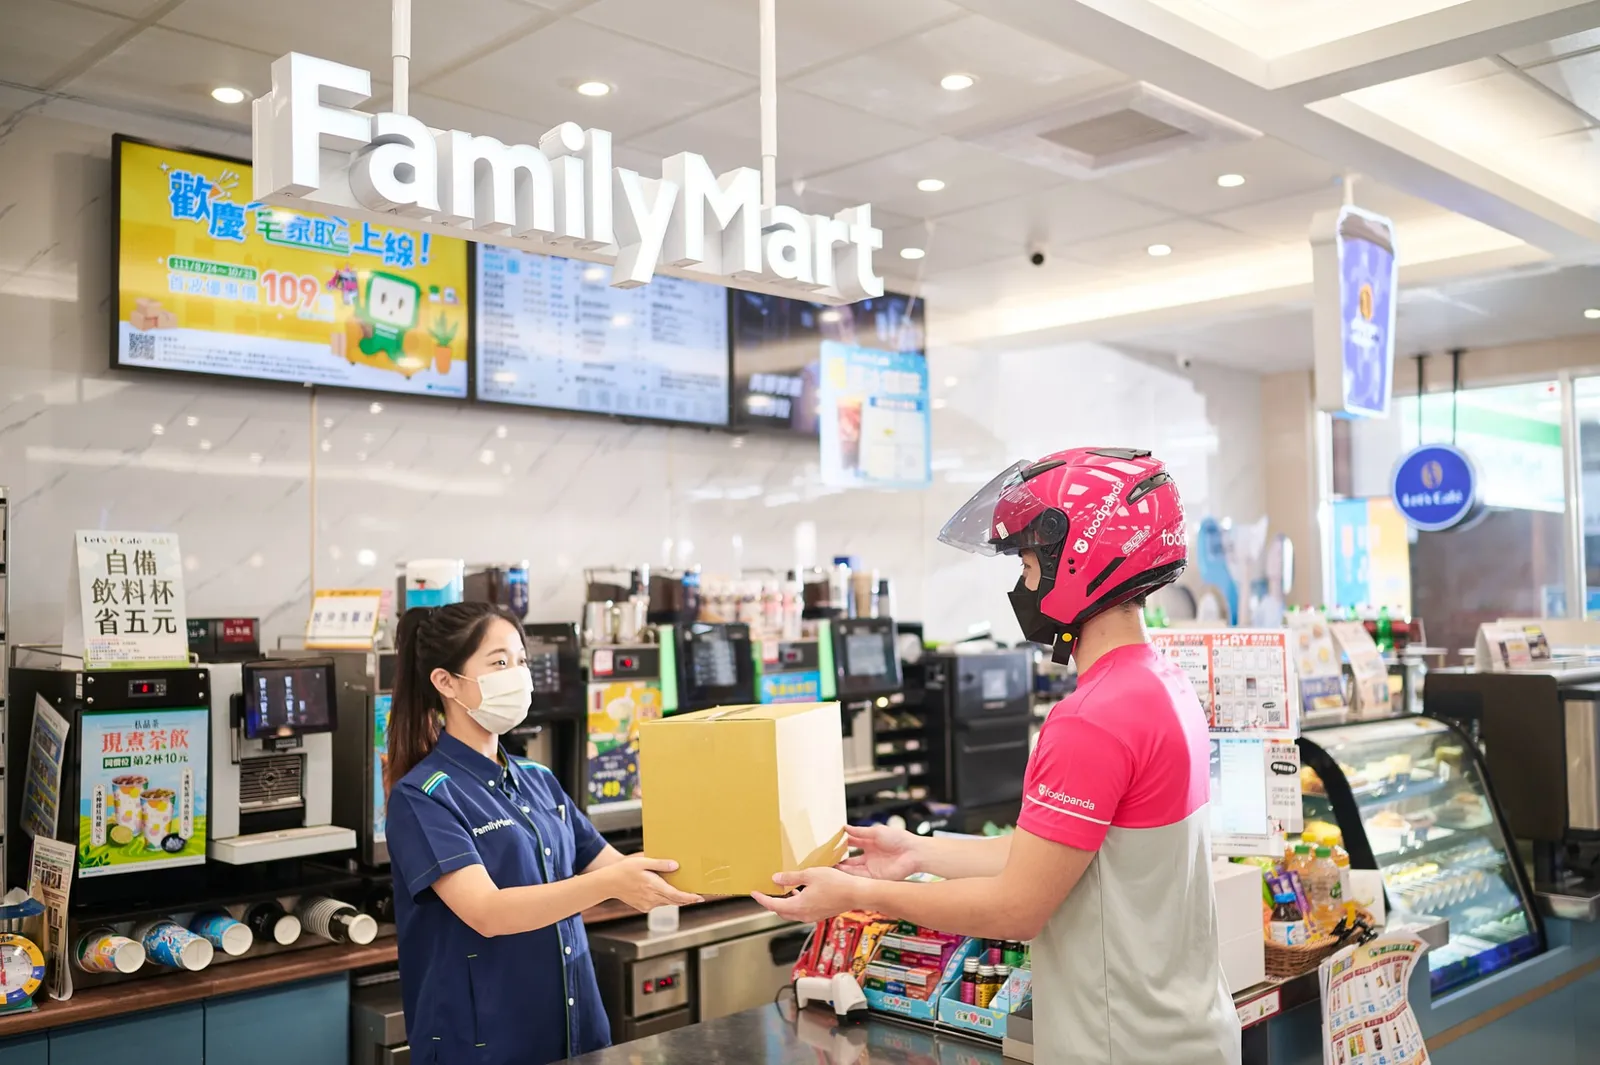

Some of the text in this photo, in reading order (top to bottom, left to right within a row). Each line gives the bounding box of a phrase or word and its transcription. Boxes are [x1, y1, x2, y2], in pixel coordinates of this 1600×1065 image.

[272, 52, 884, 298] FamilyMart
[262, 270, 318, 308] 109
[1083, 480, 1124, 539] foodpanda
[84, 536, 107, 544] Let's
[106, 549, 157, 576] 自備
[91, 578, 174, 605] 飲料杯
[95, 607, 177, 636] 省五元
[101, 729, 189, 753] 現煮茶飲
[1046, 788, 1096, 810] foodpanda
[472, 818, 515, 837] FamilyMart
